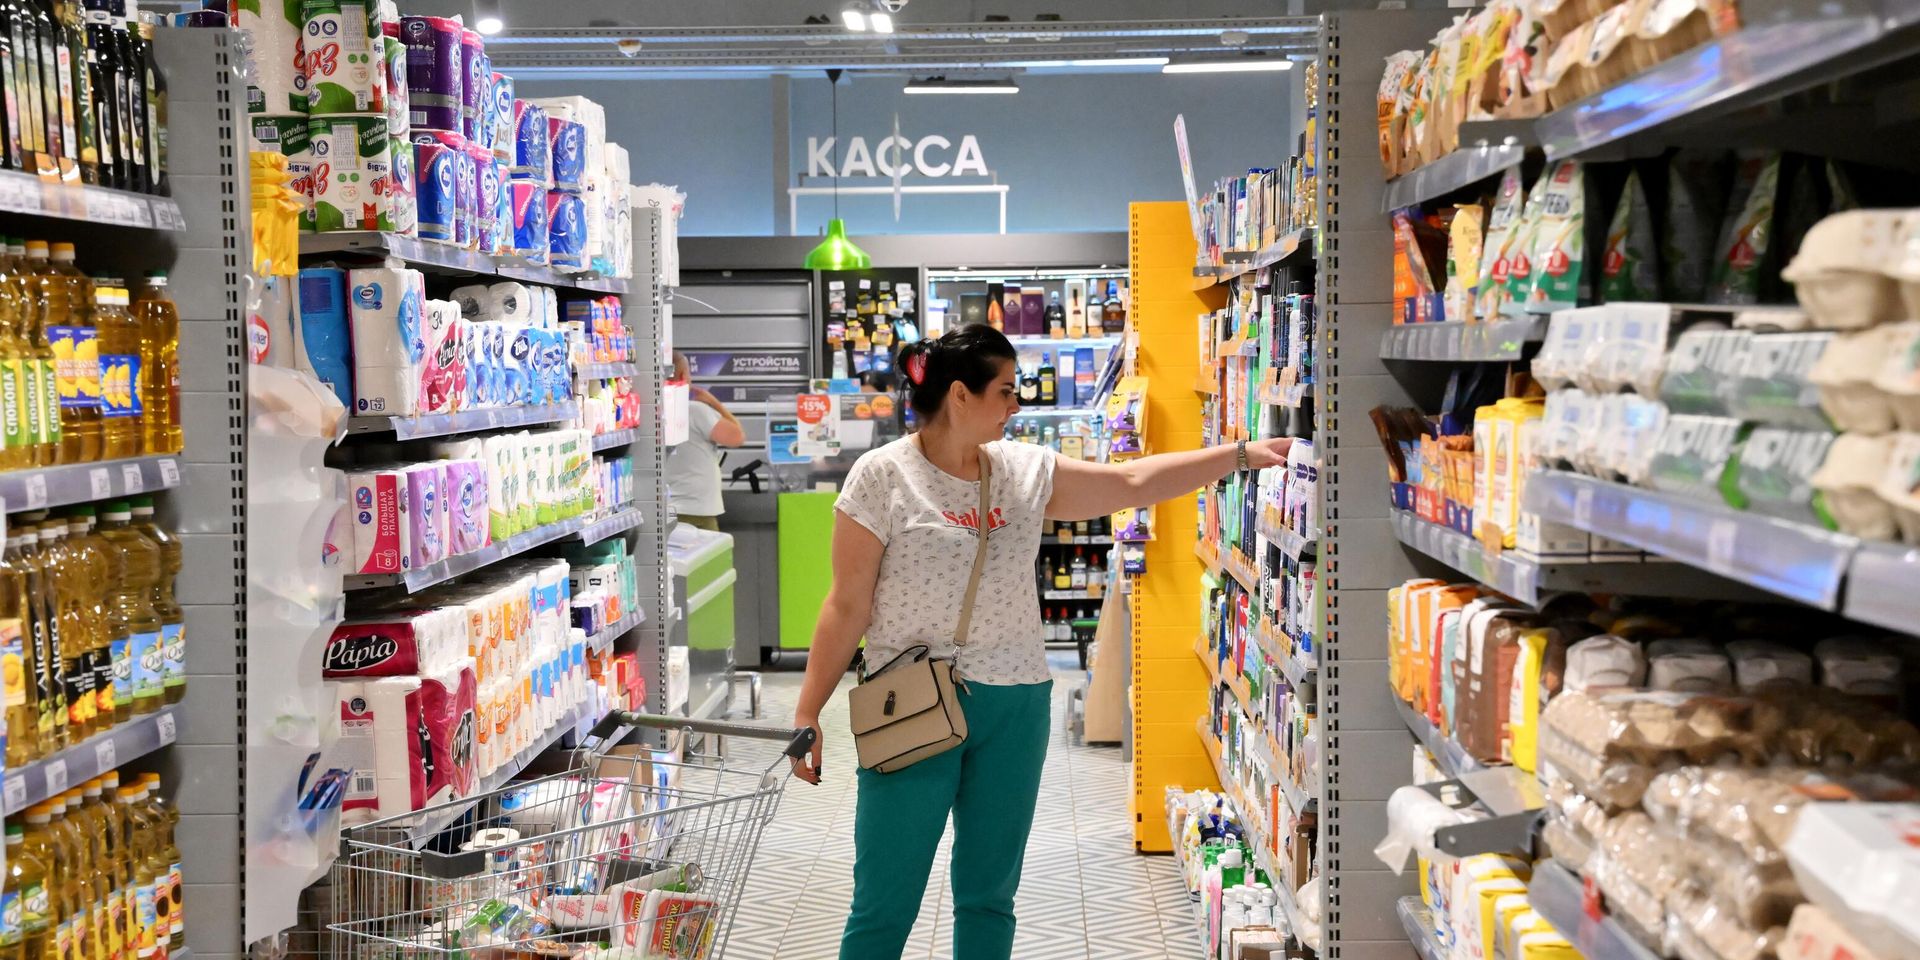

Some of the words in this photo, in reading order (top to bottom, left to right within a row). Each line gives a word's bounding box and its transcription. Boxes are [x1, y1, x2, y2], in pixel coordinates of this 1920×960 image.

[807, 135, 989, 178] КАССА
[732, 355, 800, 367] УСТРОЙСТВА
[3, 371, 19, 436] СЛОБОДА
[799, 401, 827, 411] -15%
[380, 491, 389, 537] БОЛЬШАЯ
[388, 488, 396, 536] УПАКОВКА
[33, 621, 48, 692] Altero
[50, 616, 65, 686] Altero
[325, 635, 392, 669] Papia
